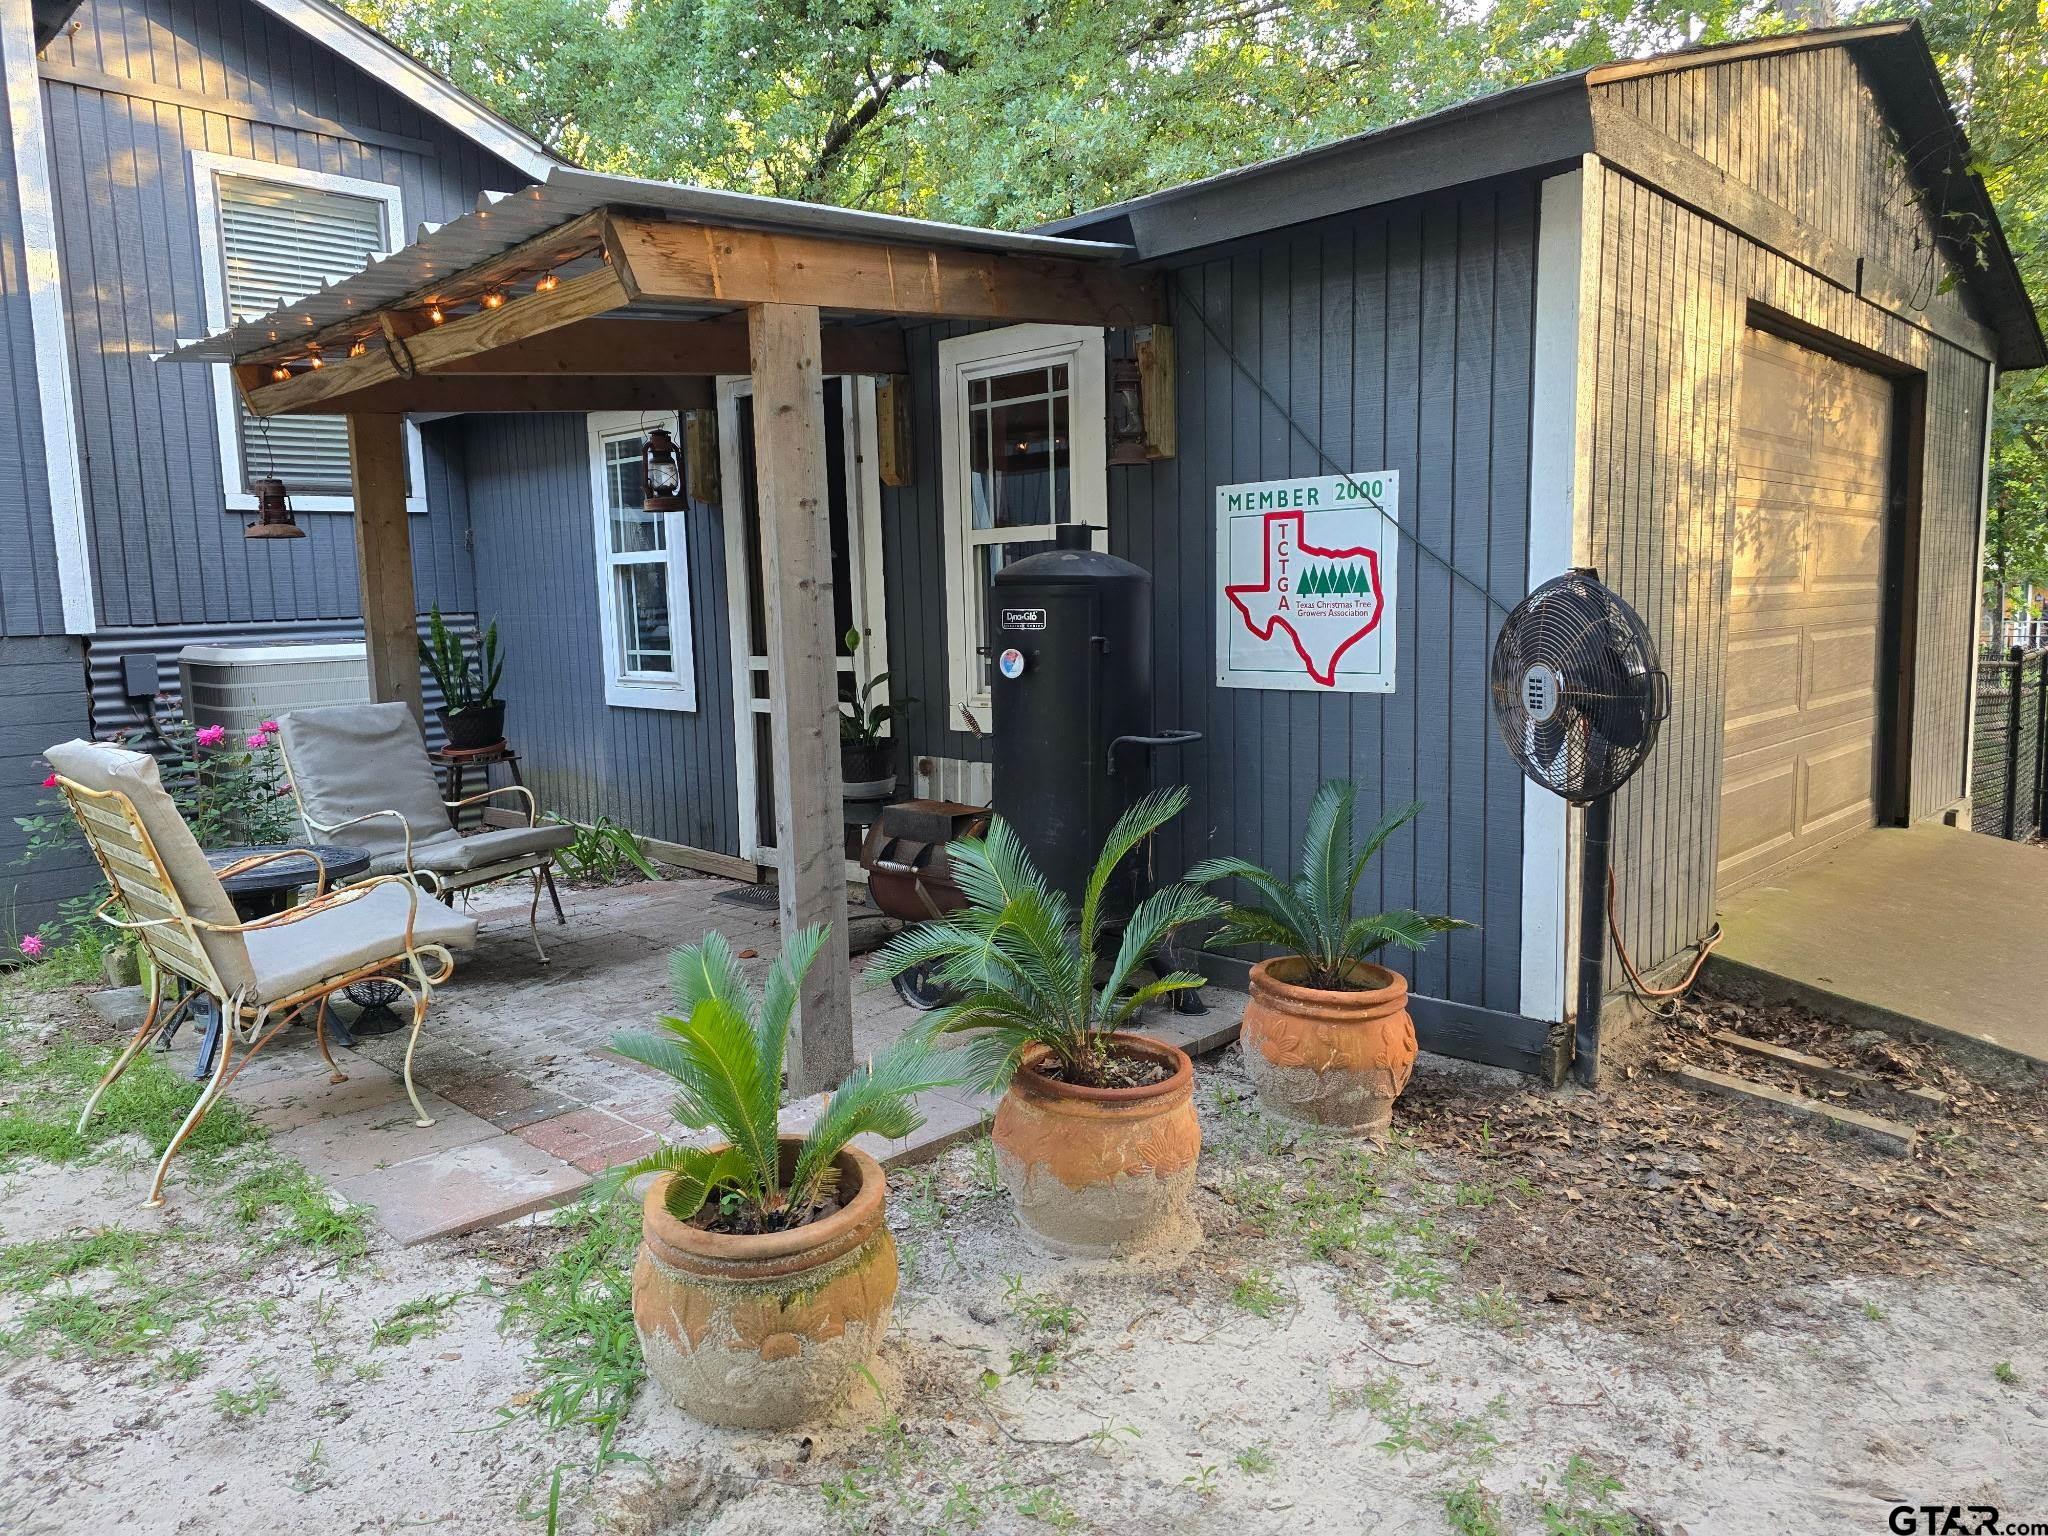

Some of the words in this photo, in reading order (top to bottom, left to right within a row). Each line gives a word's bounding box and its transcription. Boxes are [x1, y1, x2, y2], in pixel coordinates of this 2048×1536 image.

[1228, 487, 1319, 511] MEMBER
[1335, 480, 1383, 500] 2000
[1317, 600, 1352, 608] Christmas
[1355, 600, 1372, 608] Tree
[1297, 609, 1326, 617] Growers
[1328, 608, 1369, 617] Association
